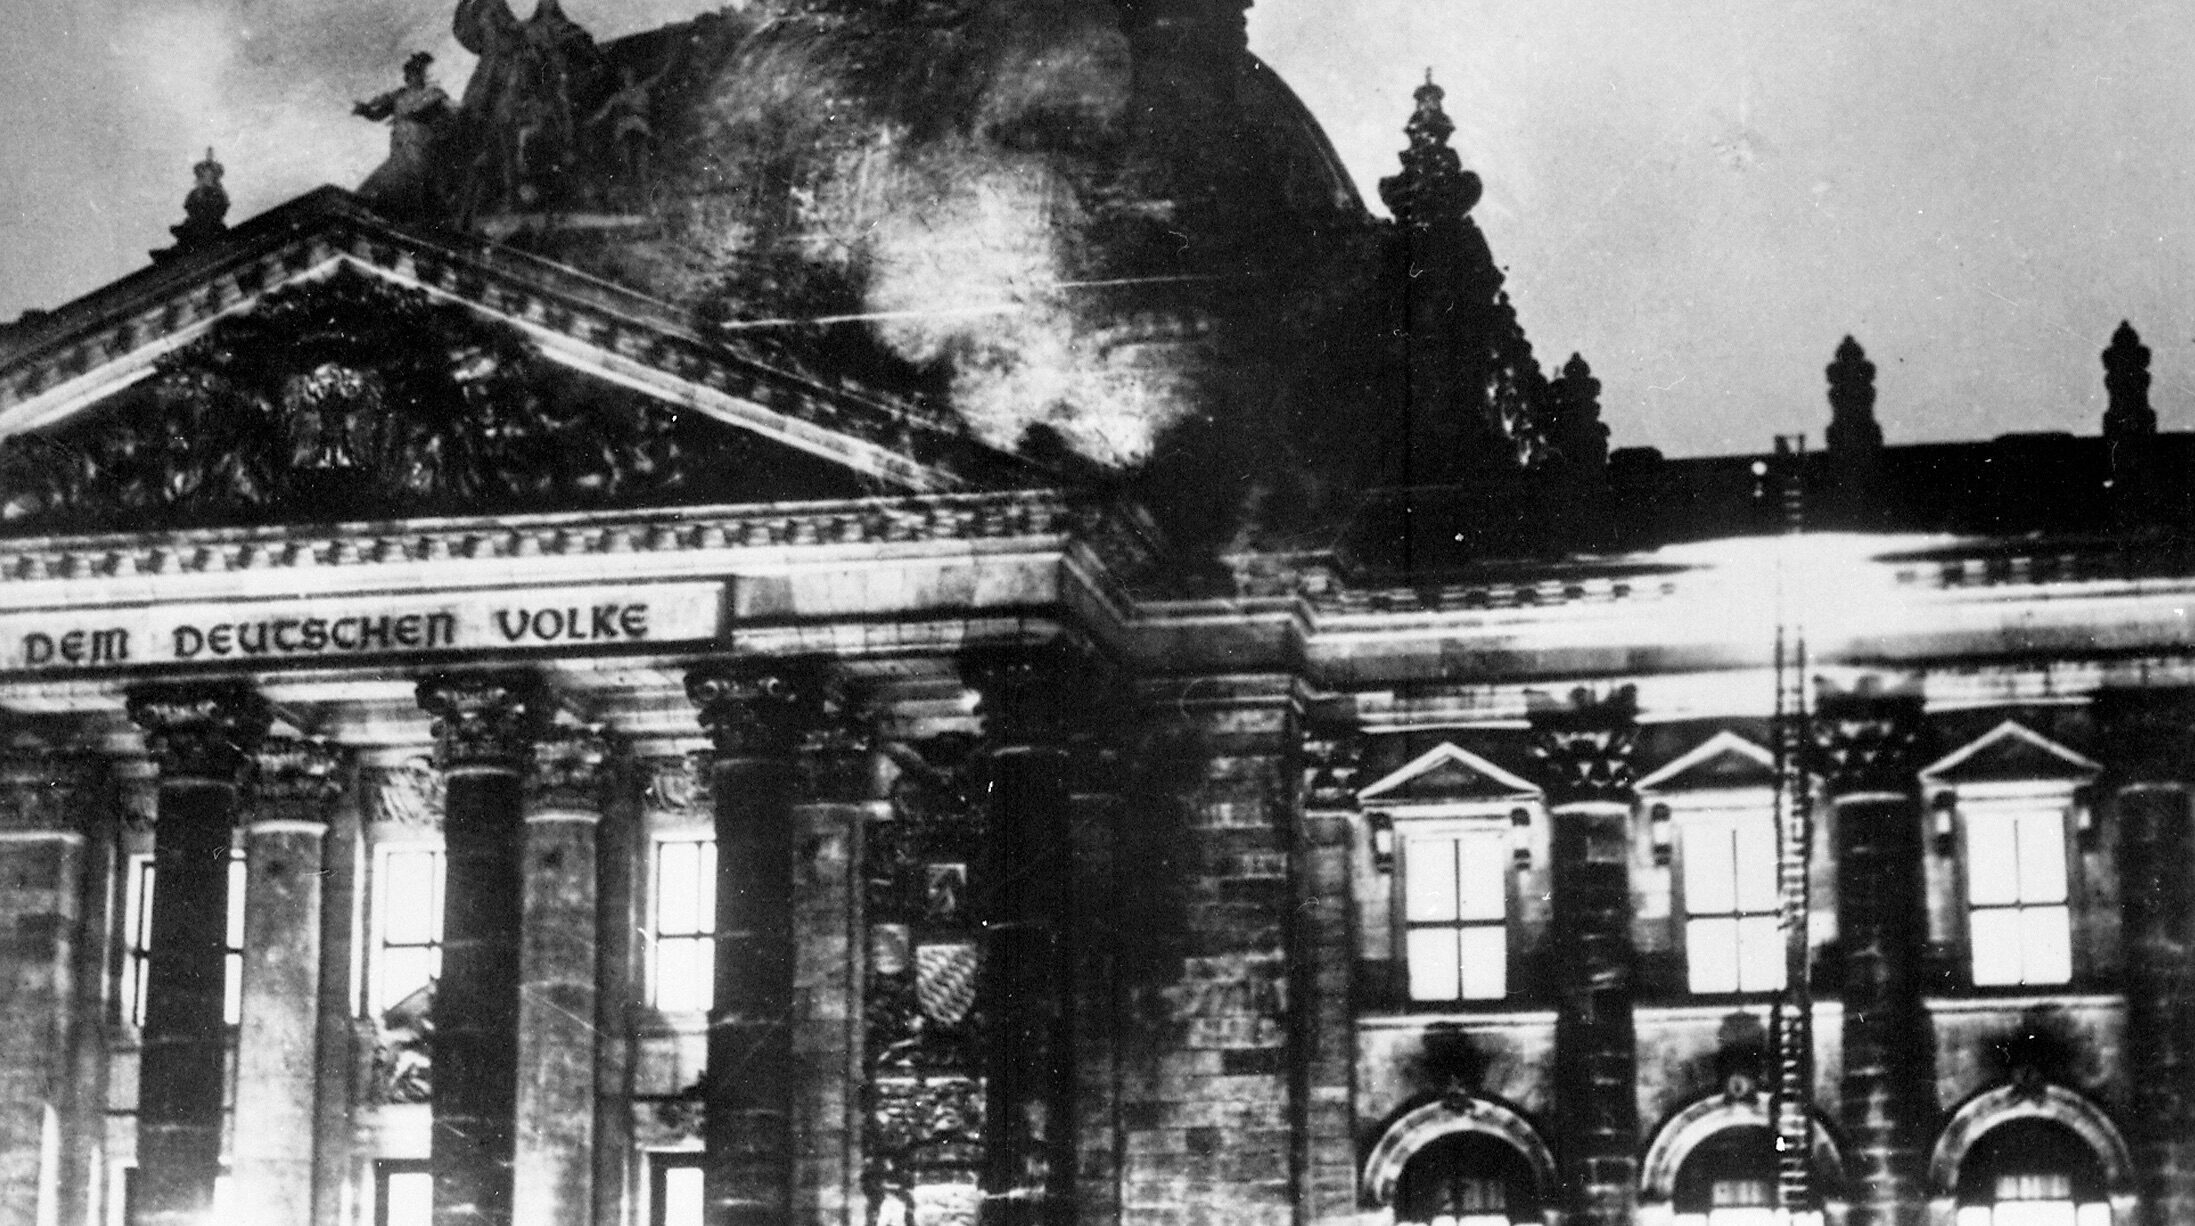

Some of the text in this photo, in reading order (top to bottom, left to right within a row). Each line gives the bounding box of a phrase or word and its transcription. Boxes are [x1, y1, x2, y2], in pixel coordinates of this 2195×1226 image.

[24, 603, 649, 666] DEM DEUTSCHEN VOLKE
